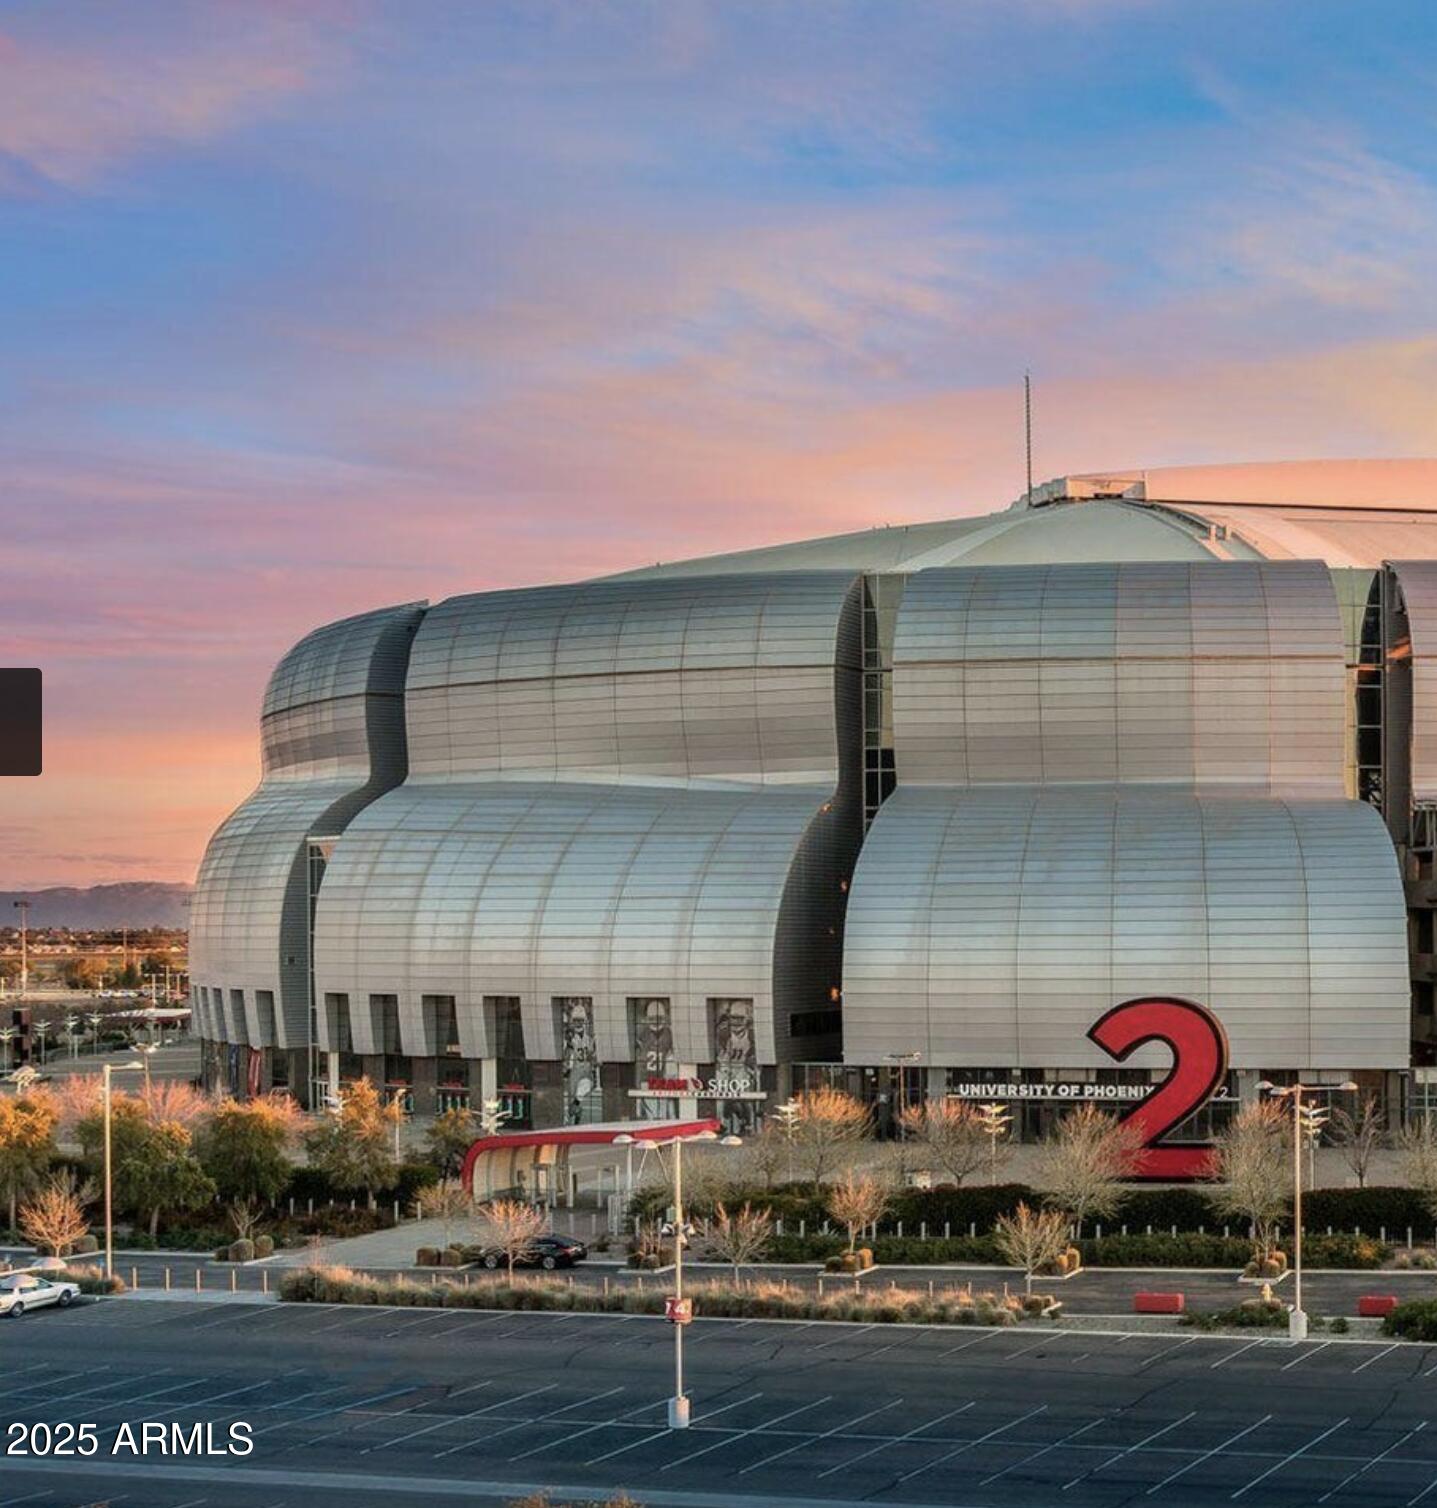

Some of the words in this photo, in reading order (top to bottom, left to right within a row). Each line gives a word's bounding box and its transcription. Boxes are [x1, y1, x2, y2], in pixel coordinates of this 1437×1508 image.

[646, 1051, 664, 1072] 21
[708, 1079, 750, 1093] SHOP
[959, 1083, 1053, 1097] UNIVERSITY
[1058, 1084, 1080, 1097] OF
[1086, 997, 1229, 1183] 2
